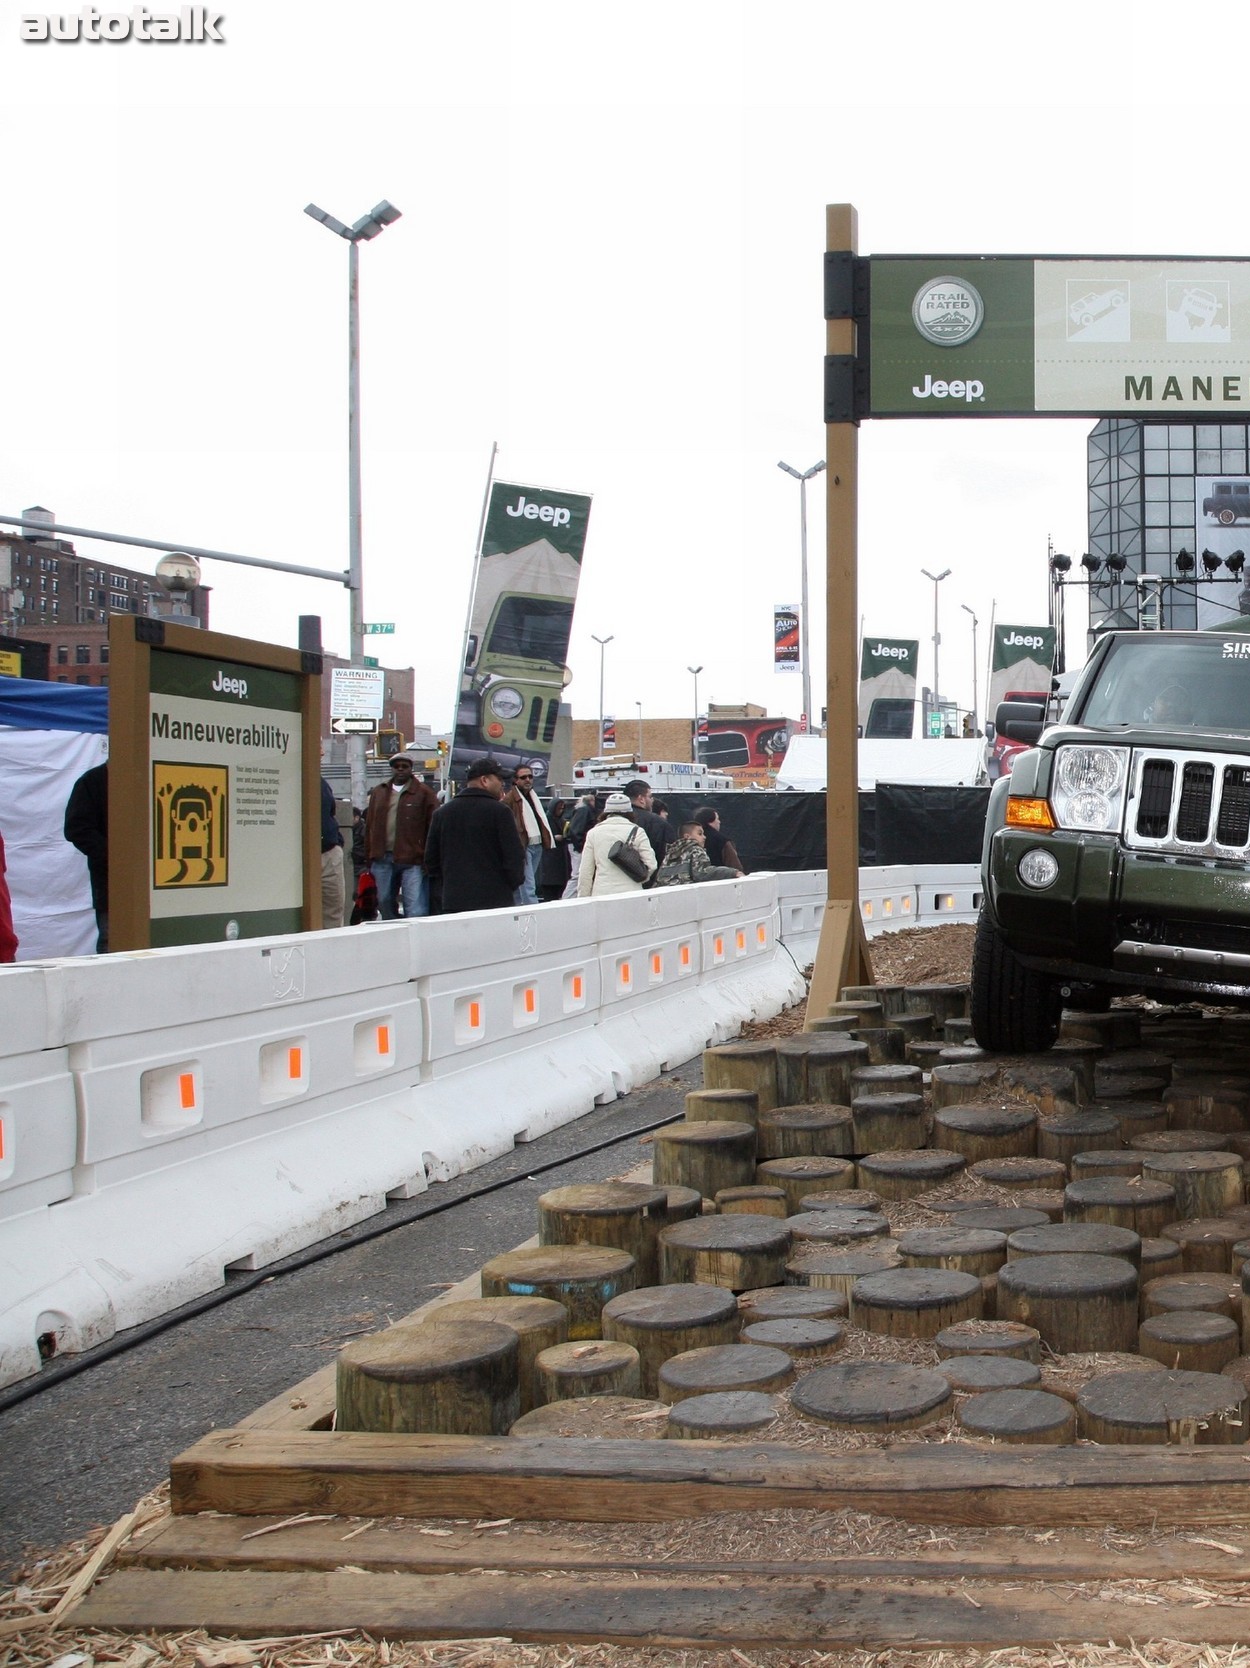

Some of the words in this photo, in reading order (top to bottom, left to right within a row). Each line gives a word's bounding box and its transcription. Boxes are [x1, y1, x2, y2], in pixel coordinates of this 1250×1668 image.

[929, 293, 969, 301] TRAIL
[926, 301, 970, 310] RATED
[912, 374, 985, 402] Jeep
[506, 496, 571, 528] Jeep
[366, 624, 374, 634] W
[776, 620, 798, 628] AUTO
[1003, 631, 1044, 650] Jeep
[871, 643, 909, 660] Jeep
[334, 670, 378, 679] WARNING
[212, 670, 248, 699] Jeep
[151, 712, 290, 755] Maneuverability
[674, 764, 690, 774] POLICE
